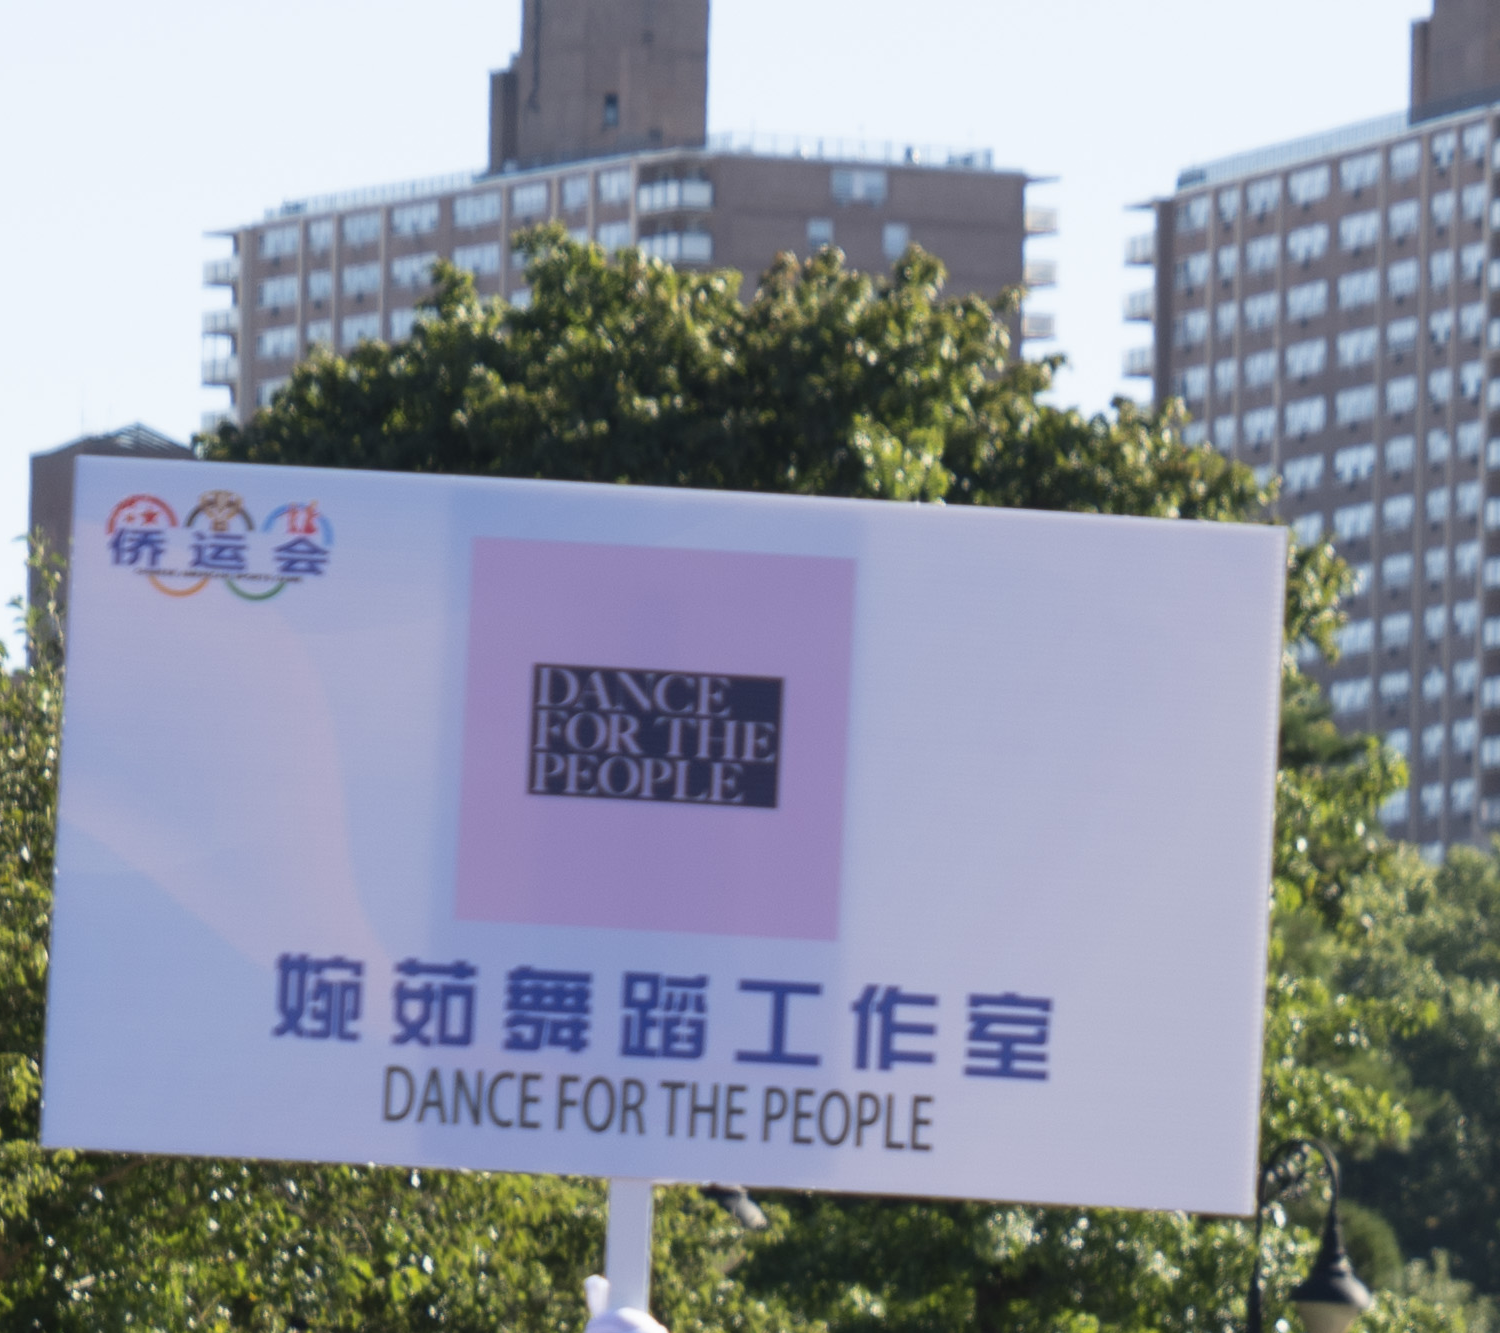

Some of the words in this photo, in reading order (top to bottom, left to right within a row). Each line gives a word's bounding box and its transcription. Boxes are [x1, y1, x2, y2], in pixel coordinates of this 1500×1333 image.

[108, 527, 329, 576] 侨运会
[536, 666, 731, 717] DANCE
[533, 709, 644, 756] FOR
[653, 716, 777, 763] THE
[532, 752, 745, 803] PEOPLE
[272, 953, 1054, 1081] 婉茹舞蹈工作室
[383, 1065, 543, 1129] DANCE
[556, 1073, 648, 1135] FOR
[659, 1080, 748, 1141] THE
[761, 1086, 936, 1152] PEOPLE
